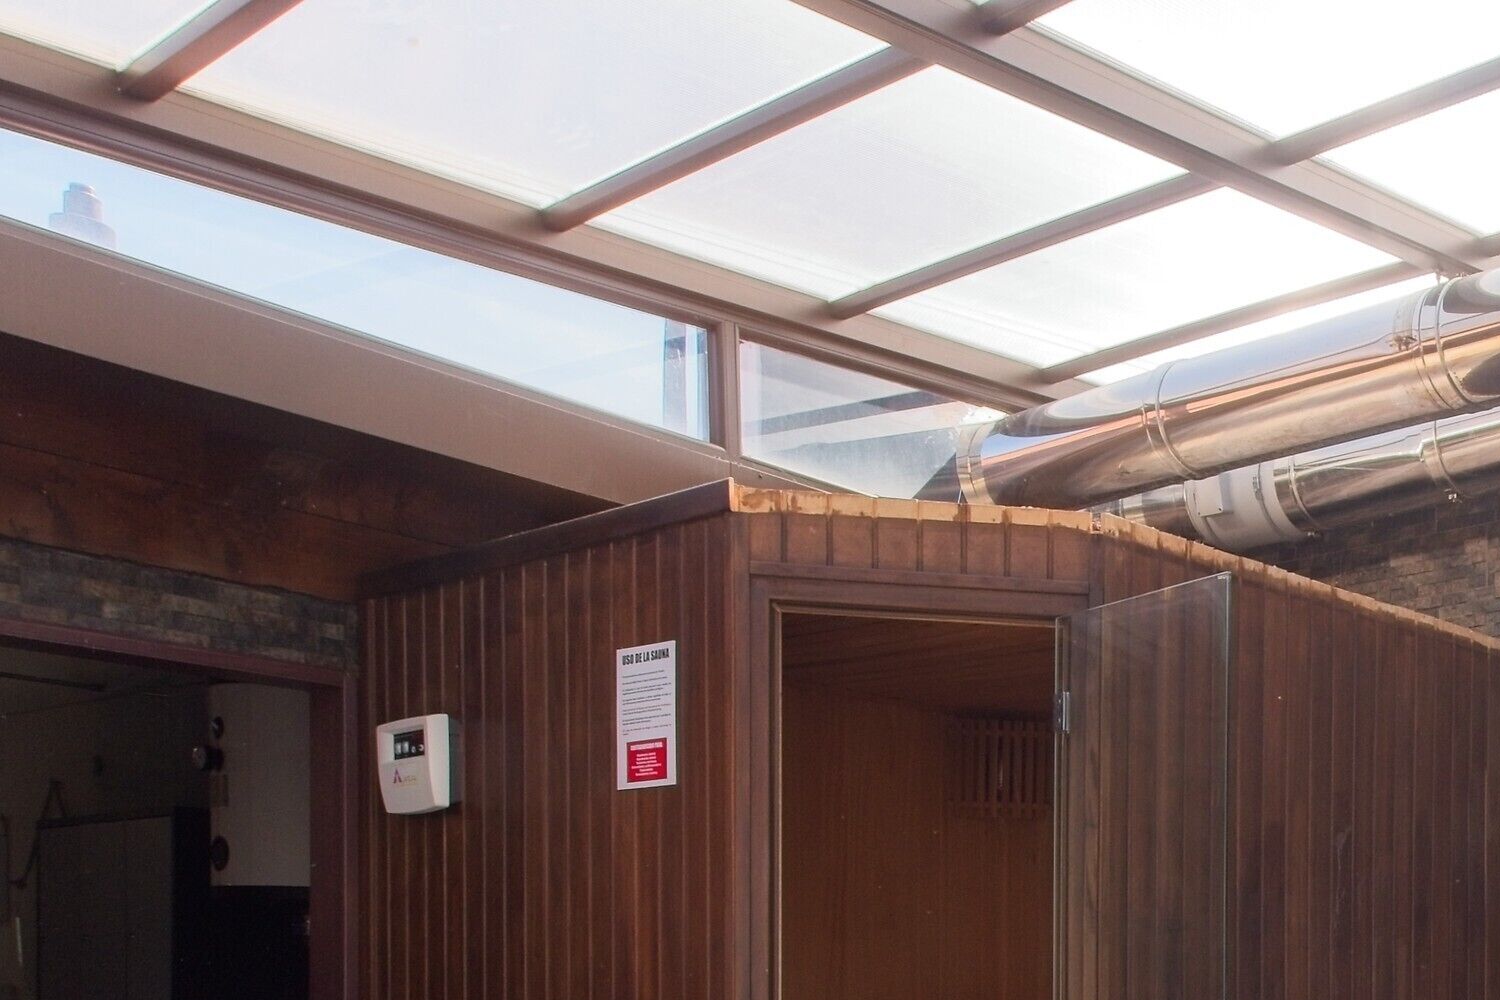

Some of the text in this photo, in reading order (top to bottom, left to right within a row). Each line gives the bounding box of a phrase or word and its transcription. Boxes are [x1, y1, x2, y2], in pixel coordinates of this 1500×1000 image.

[622, 648, 670, 666] USO DE LA SAUNA
